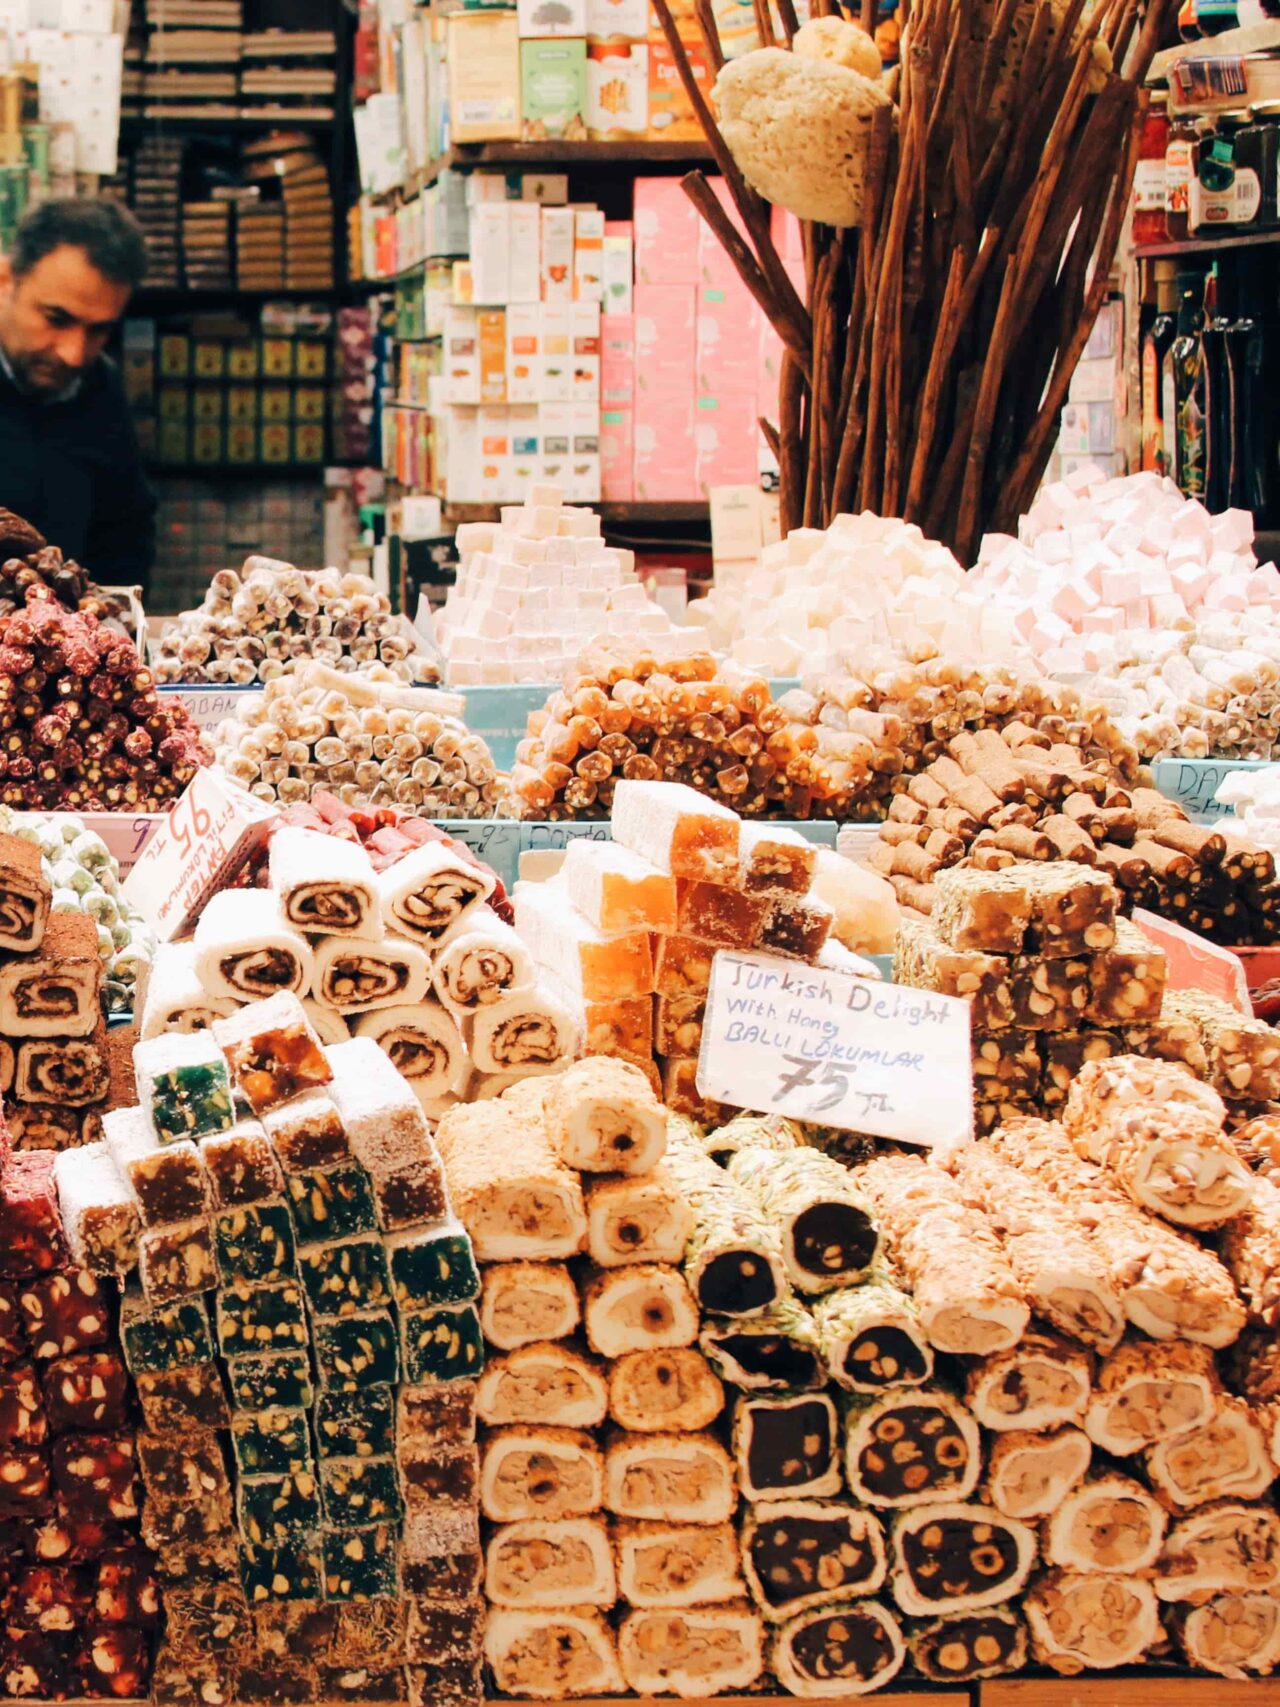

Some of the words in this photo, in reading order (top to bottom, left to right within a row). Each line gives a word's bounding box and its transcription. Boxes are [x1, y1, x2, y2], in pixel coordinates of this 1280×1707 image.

[169, 780, 211, 860] 95
[184, 838, 228, 911] ANTEP
[722, 957, 833, 1004] Turkish
[846, 984, 951, 1026] Delight
[726, 998, 777, 1020] With
[786, 1007, 840, 1040] Honey
[723, 1021, 792, 1049] BALLI
[771, 1053, 857, 1112] 75
